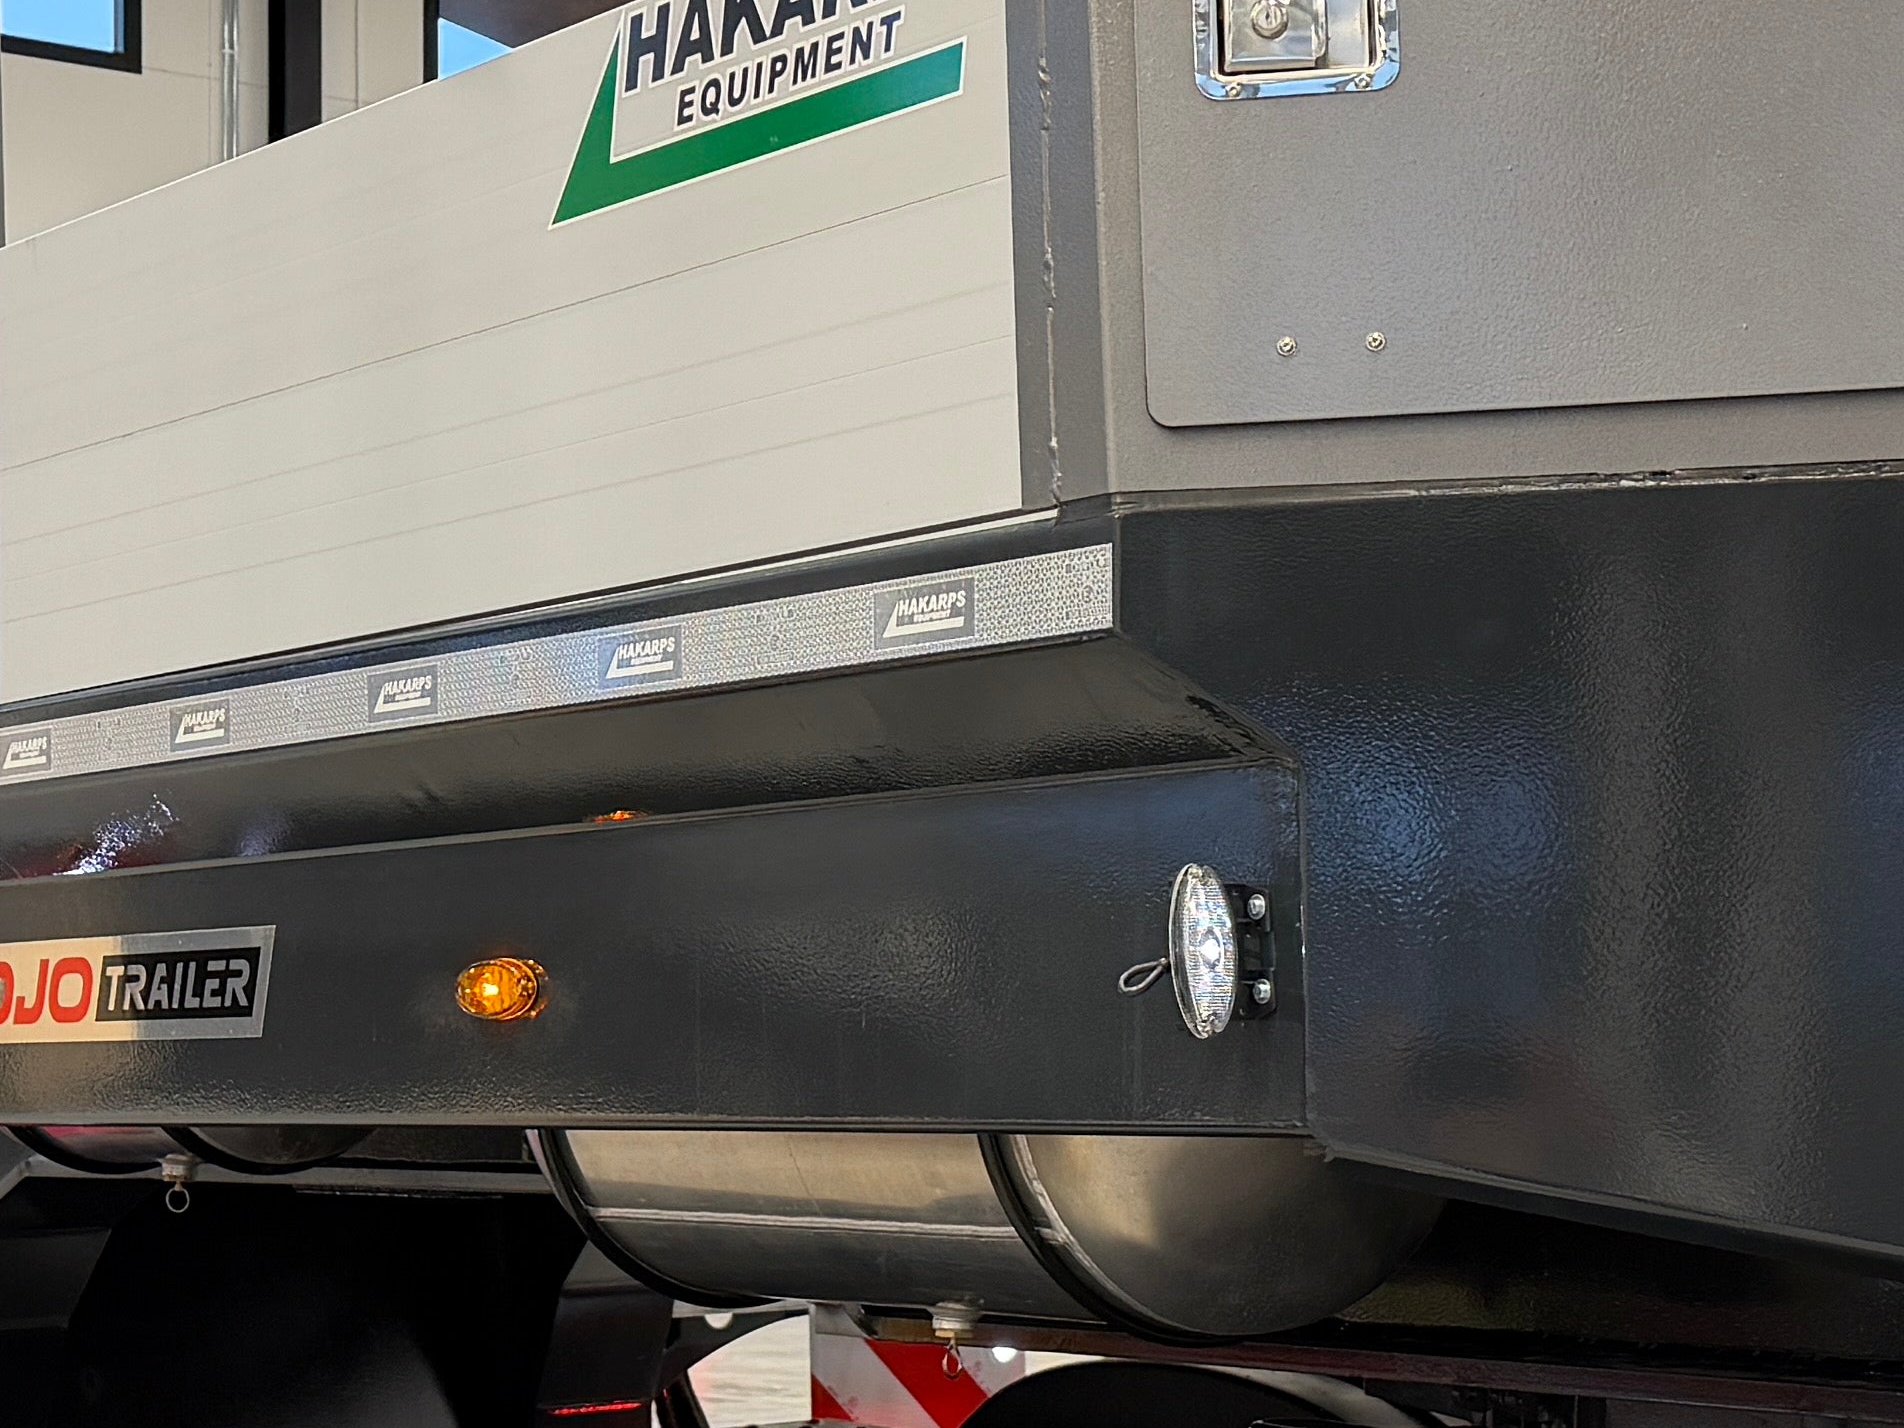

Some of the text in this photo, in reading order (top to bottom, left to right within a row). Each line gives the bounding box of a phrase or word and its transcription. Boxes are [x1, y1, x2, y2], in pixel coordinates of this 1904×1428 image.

[676, 10, 903, 128] EQUIPMENT
[897, 589, 967, 617] HAKARPS
[618, 636, 676, 660] HAKARPS
[104, 957, 252, 1013] TRAILER
